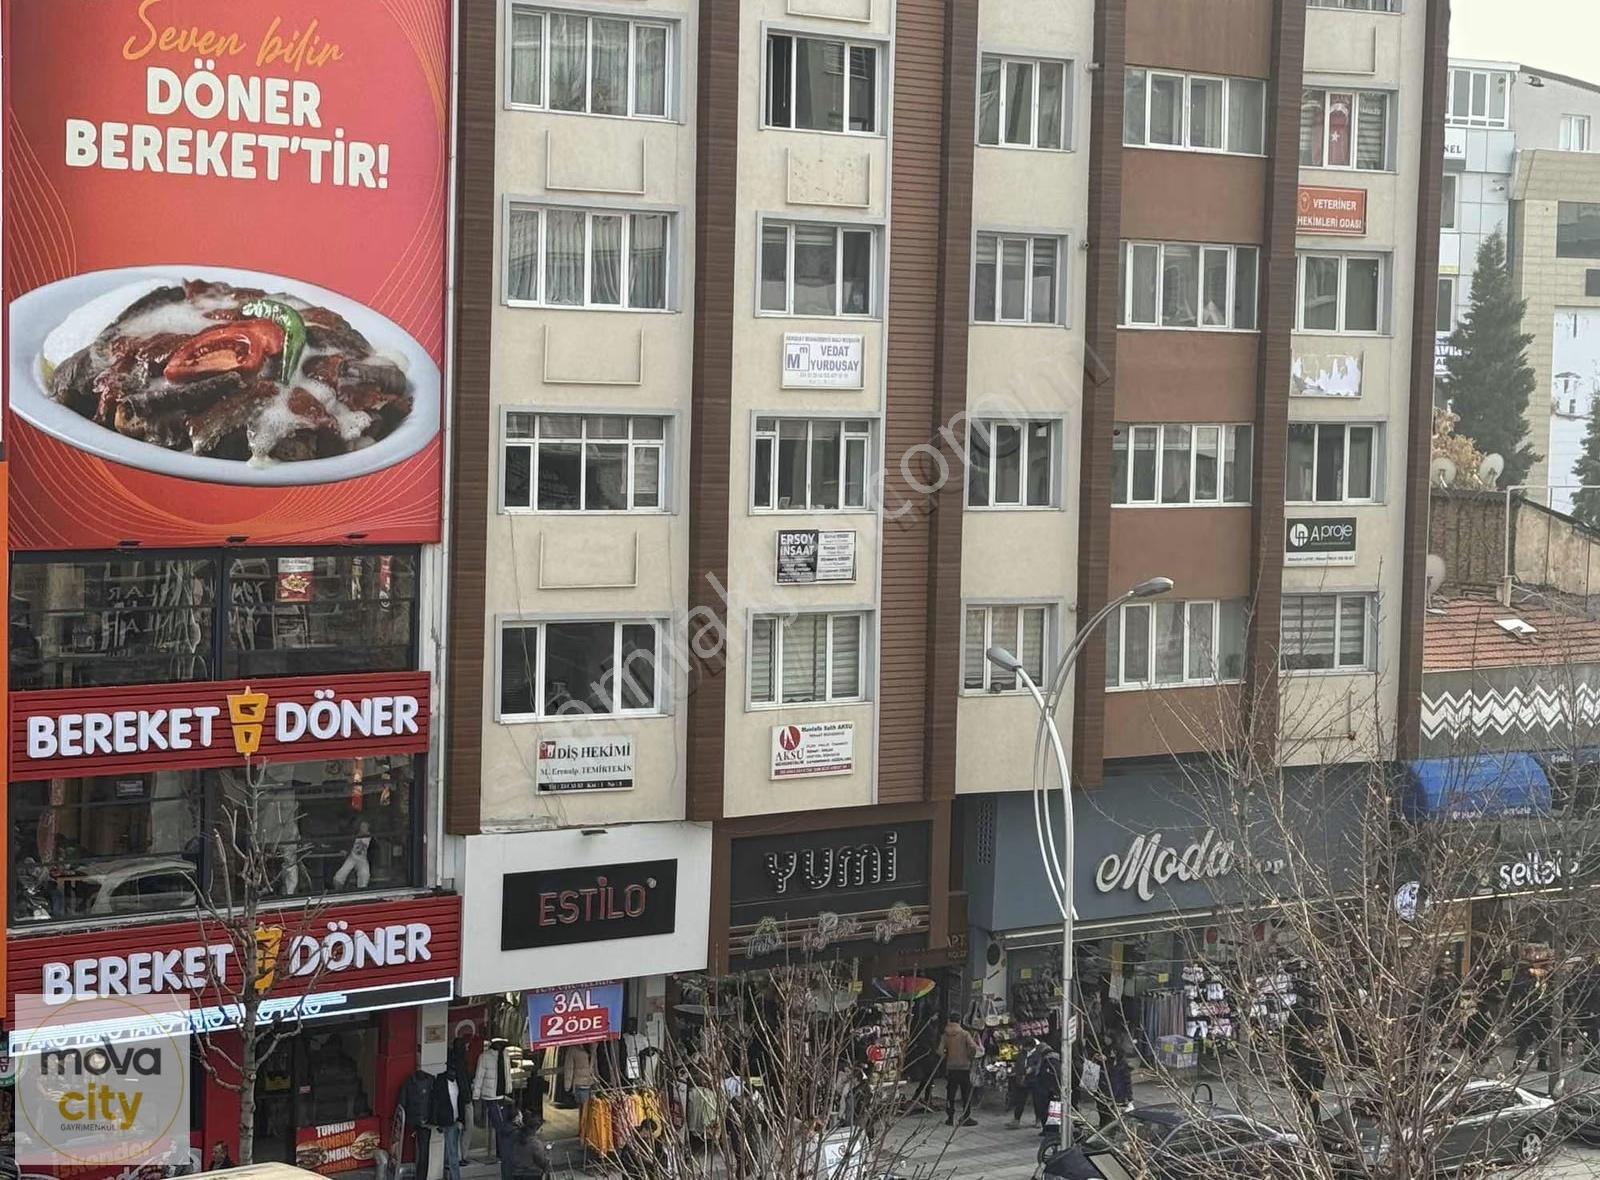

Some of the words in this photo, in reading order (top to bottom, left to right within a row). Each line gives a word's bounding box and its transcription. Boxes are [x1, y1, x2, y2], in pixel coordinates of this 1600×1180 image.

[123, 0, 247, 61] Seven
[146, 58, 322, 128] DÖNER
[65, 119, 390, 189] BEREKET'TİR!
[811, 360, 860, 372] YURDUSAY
[820, 345, 849, 357] VEDAT
[780, 533, 815, 545] ERSOY
[26, 706, 220, 759] BEREKET
[275, 689, 419, 743] DÖNER
[557, 744, 579, 761] DİŞ
[581, 742, 631, 758] HEKİMİ
[776, 748, 805, 761] AKSU
[766, 831, 898, 894] yumi
[1096, 827, 1234, 901] Moda
[538, 875, 647, 928] ESTİLO
[42, 942, 235, 1005] BEREKET
[289, 920, 432, 976] DÖNER
